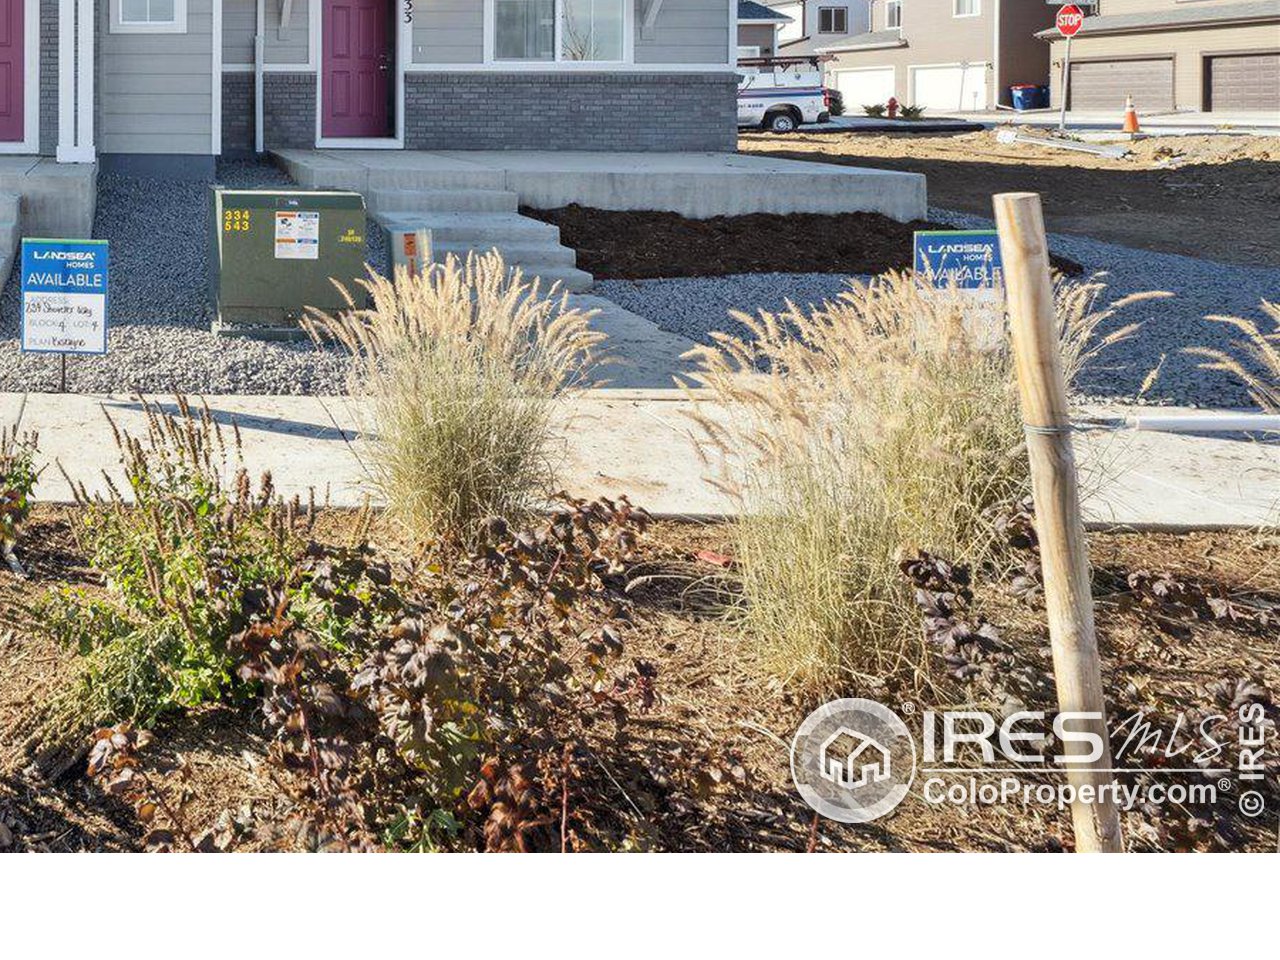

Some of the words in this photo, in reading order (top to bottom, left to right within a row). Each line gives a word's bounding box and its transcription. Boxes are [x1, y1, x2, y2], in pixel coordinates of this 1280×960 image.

[1059, 13, 1082, 27] STOP
[224, 210, 250, 221] 334
[224, 220, 250, 231] 543
[927, 243, 994, 254] LANDSEA
[33, 250, 94, 261] LANDSEA
[66, 261, 95, 270] HOMES
[26, 272, 103, 288] AVAILABLE
